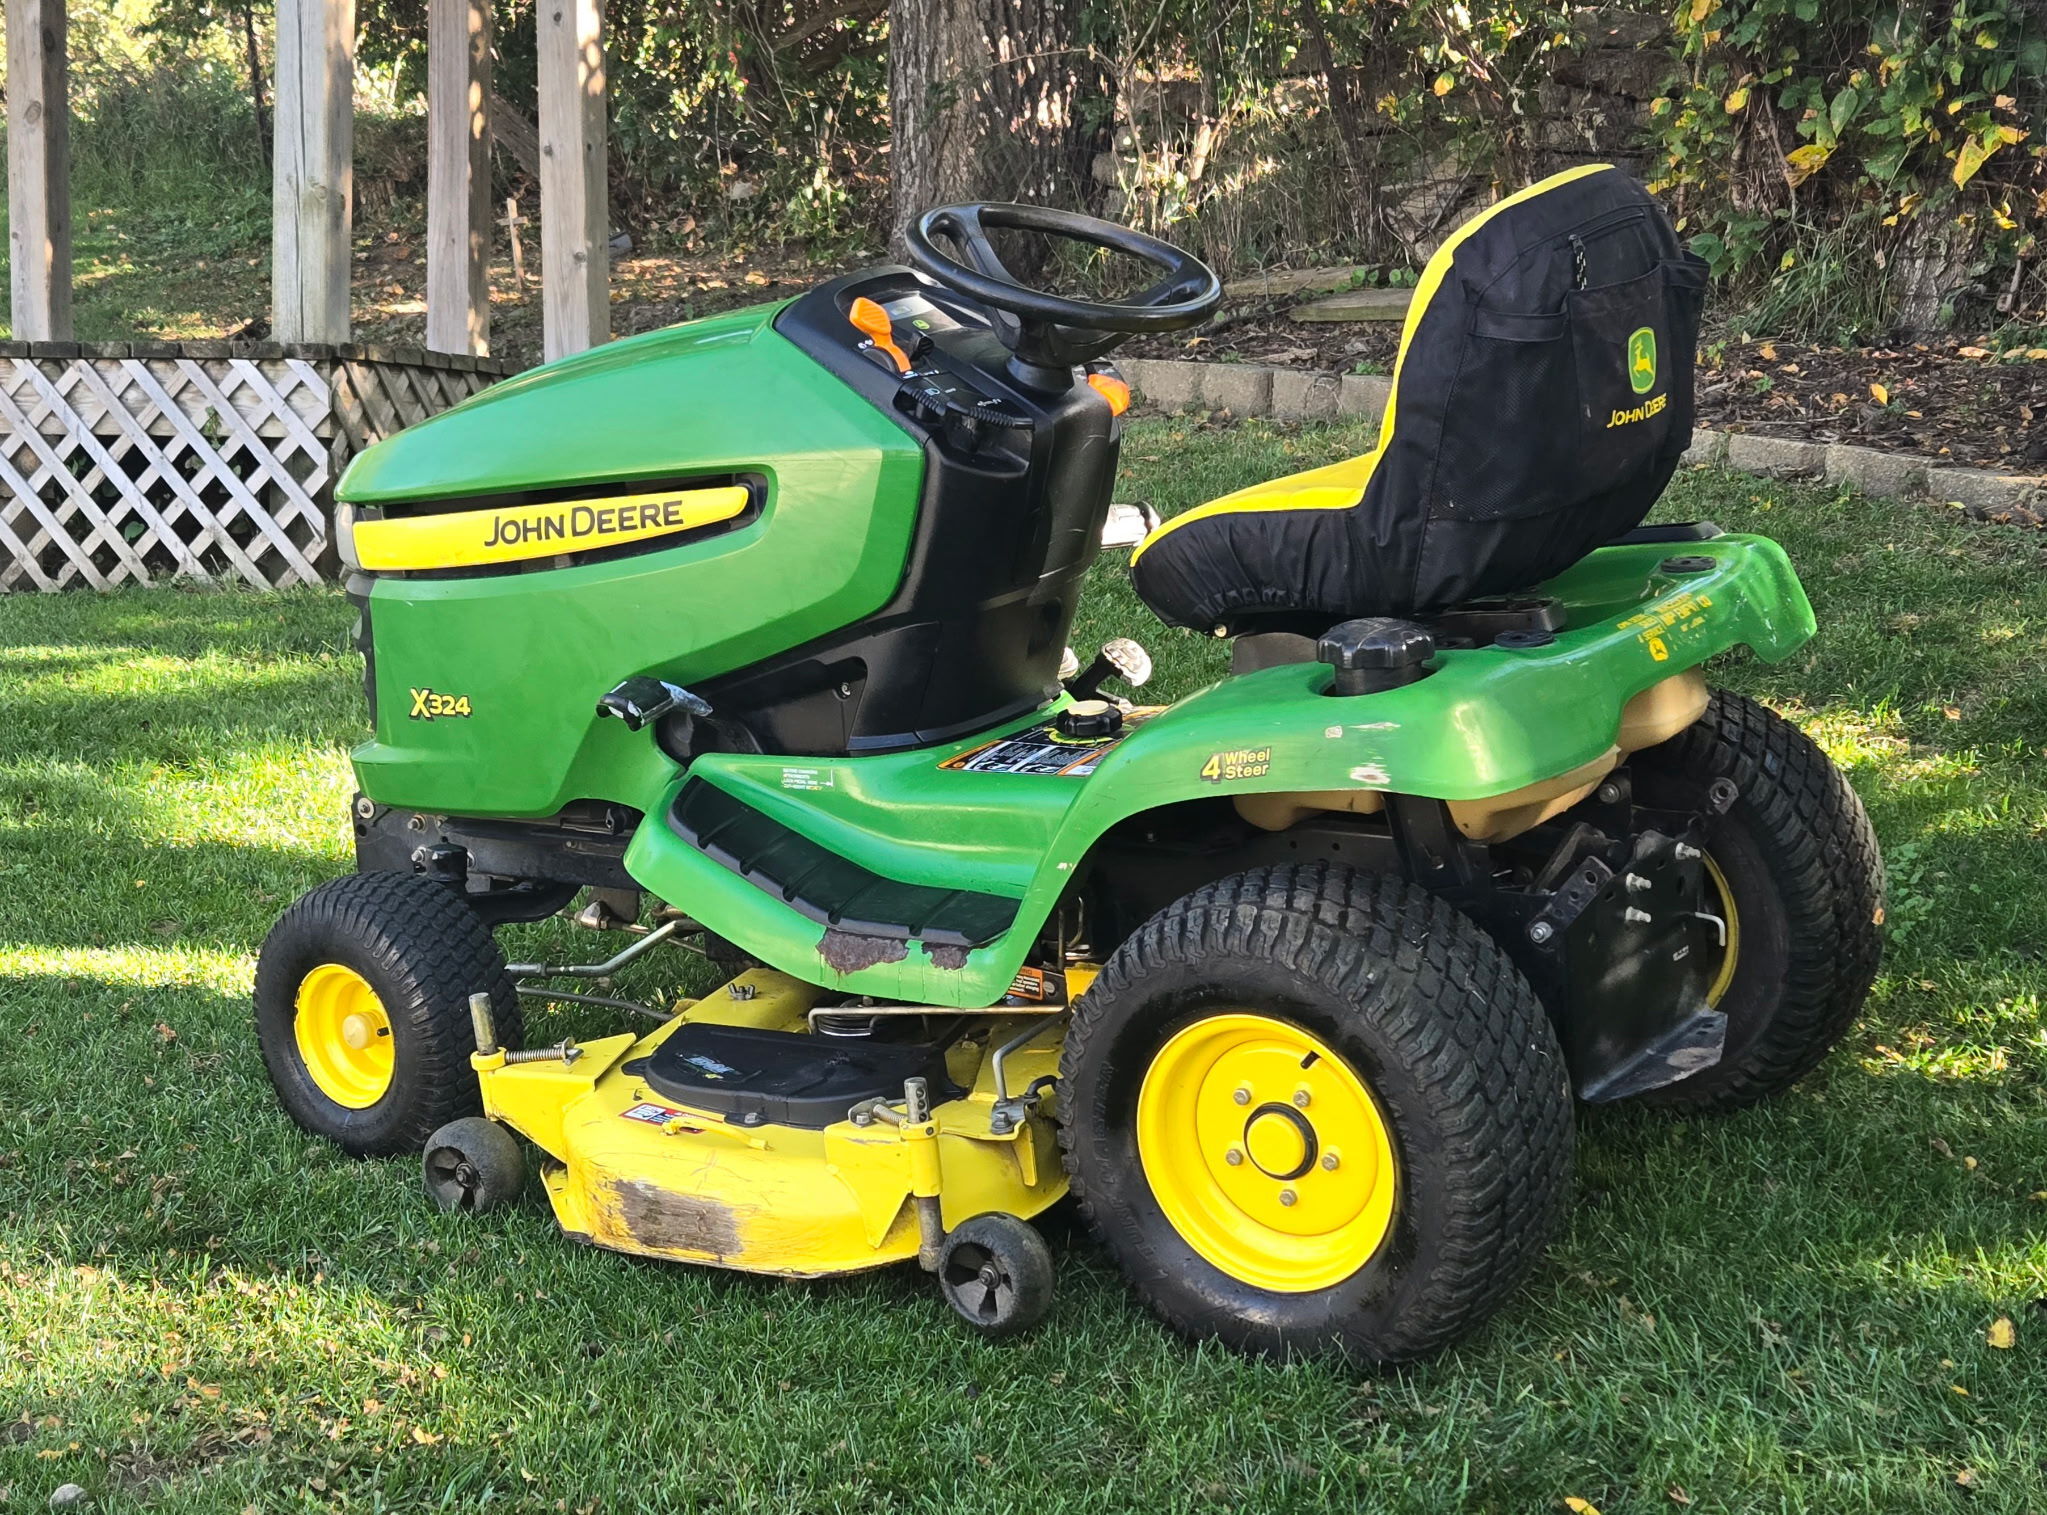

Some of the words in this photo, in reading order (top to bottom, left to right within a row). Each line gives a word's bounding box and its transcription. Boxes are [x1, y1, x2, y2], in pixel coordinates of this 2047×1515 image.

[1606, 405, 1645, 429] JOHN
[484, 514, 565, 547] JOHN
[571, 500, 684, 537] DEERE
[409, 687, 472, 720] X324
[1201, 753, 1222, 782] 4
[1224, 747, 1271, 766] Wheel
[1225, 763, 1270, 780] Steer
